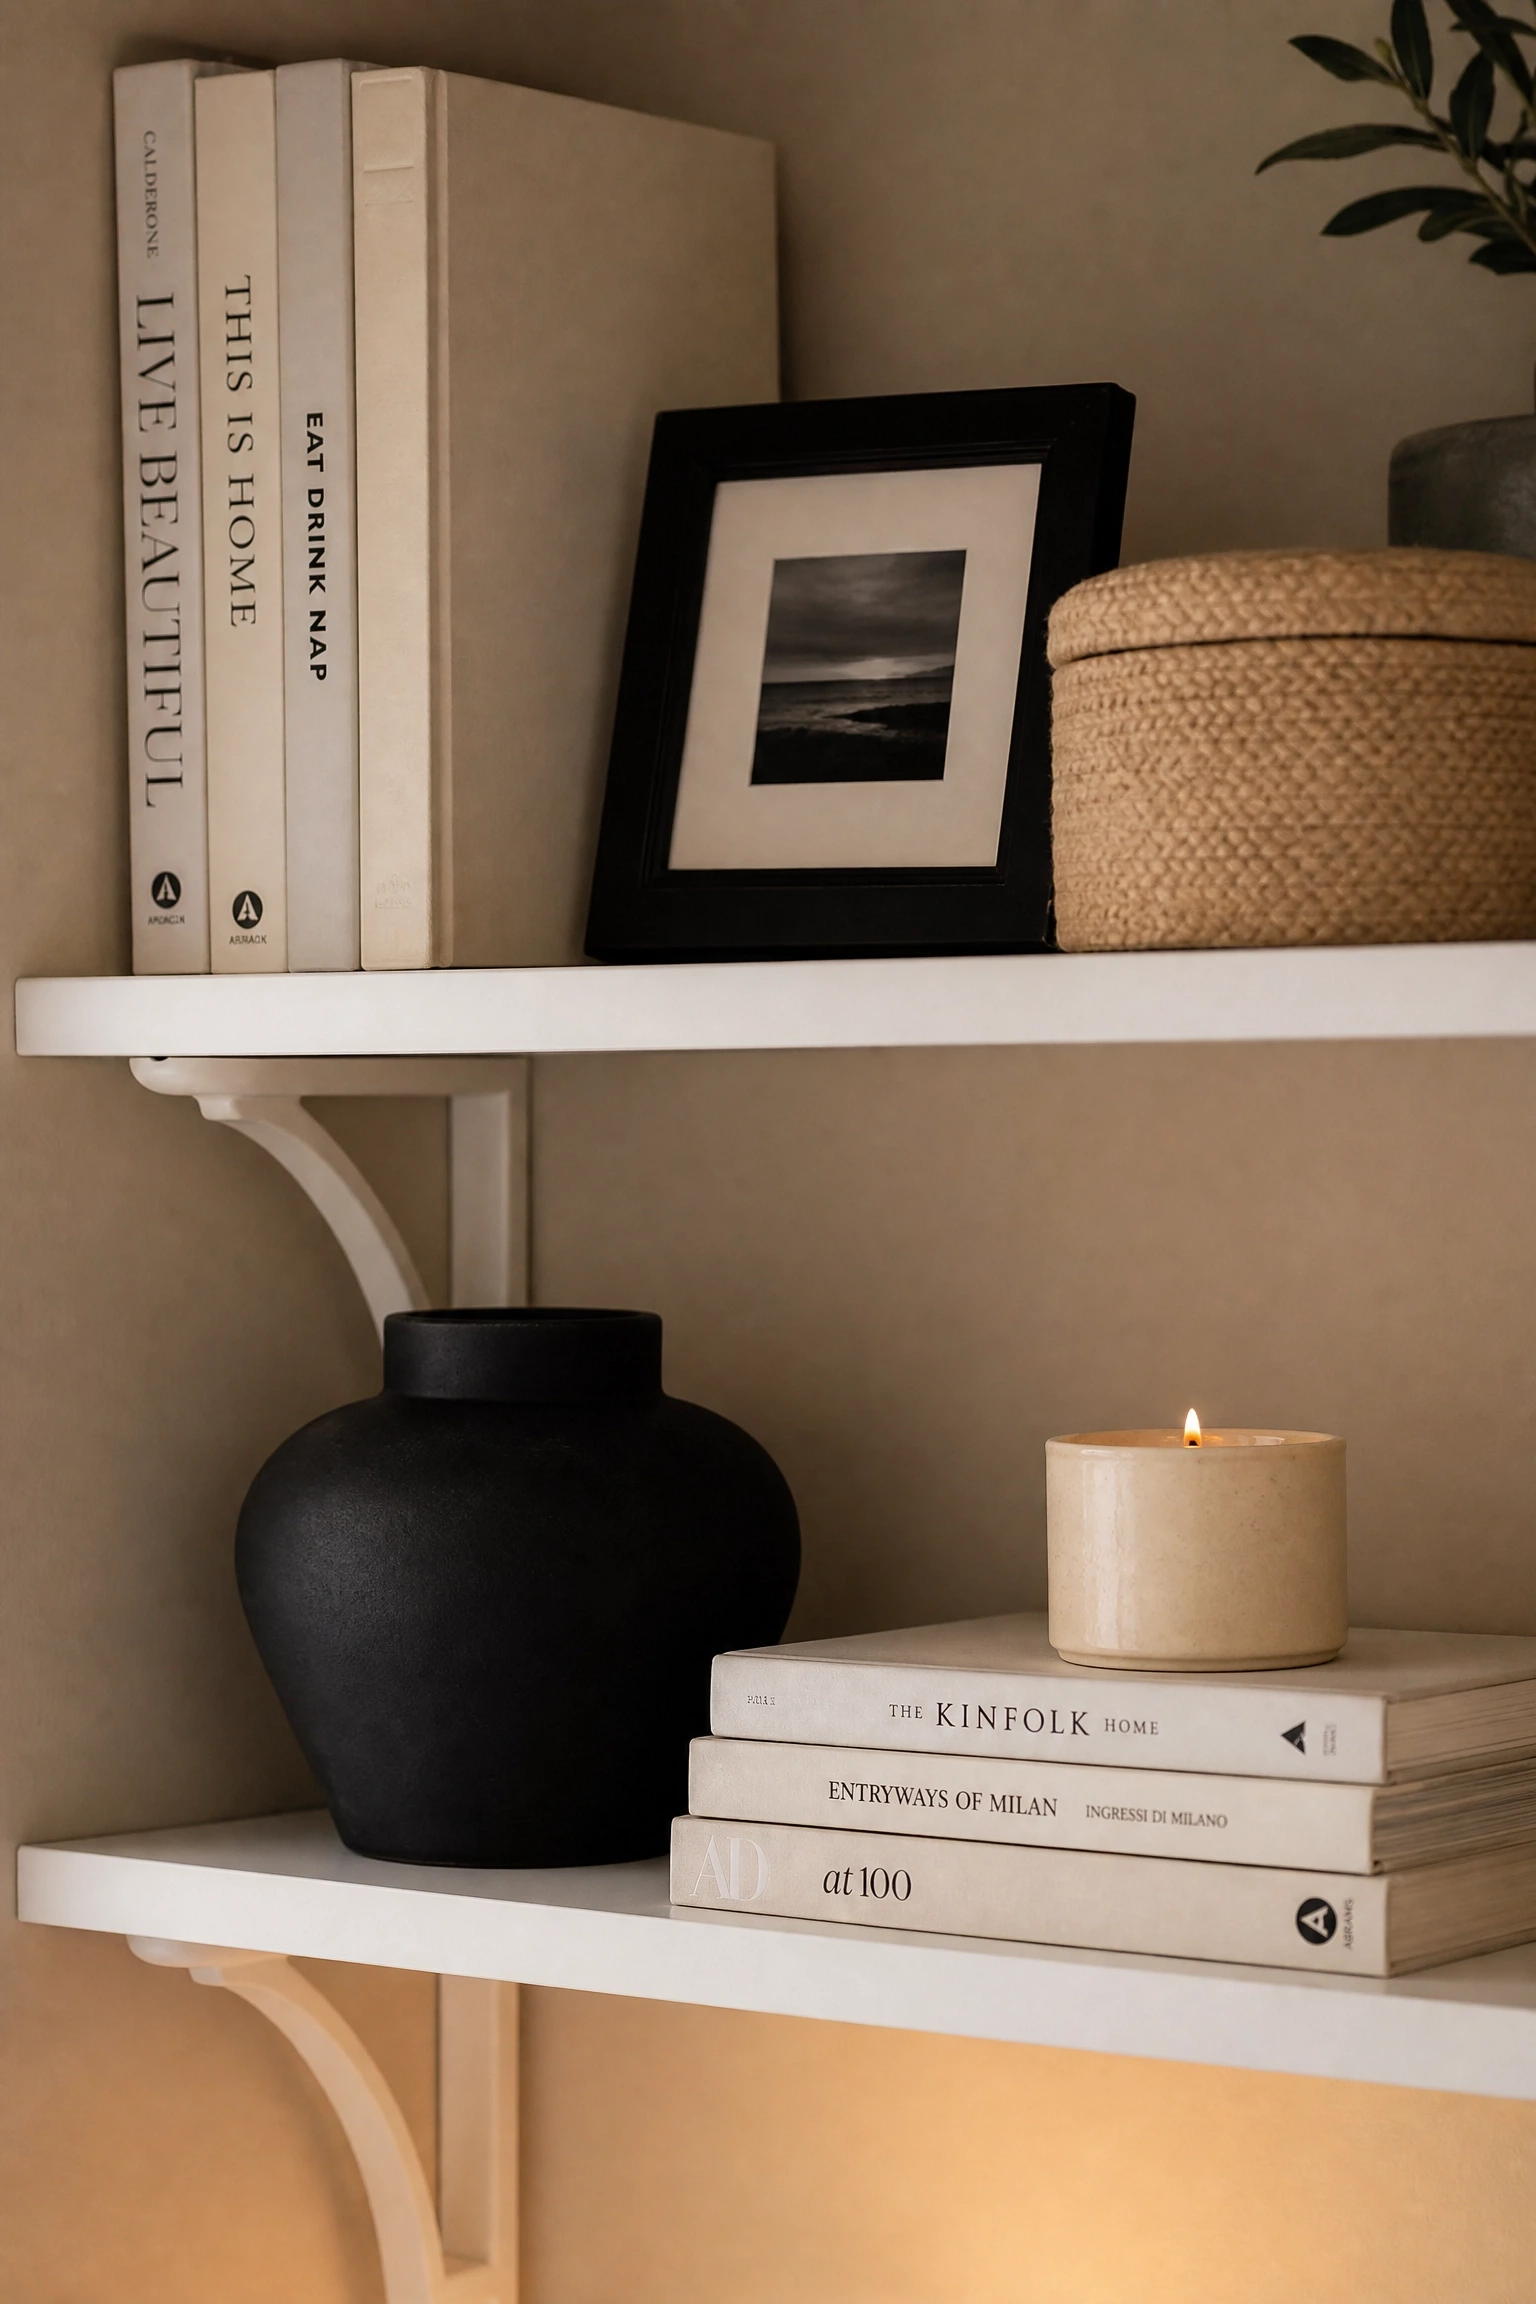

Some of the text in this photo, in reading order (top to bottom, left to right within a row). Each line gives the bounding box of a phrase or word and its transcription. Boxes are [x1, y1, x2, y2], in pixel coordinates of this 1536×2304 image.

[143, 129, 160, 259] CALDERONE
[224, 273, 256, 627] THIS IS HOME
[136, 292, 183, 809] LIVE BEAUTIFUL
[306, 412, 327, 681] EAT DRINK NAP
[888, 1701, 1160, 1737] THE KINFOLK HOME
[828, 1780, 1058, 1818] ENTRYWAYS OF MILAN
[1085, 1804, 1229, 1829] INGRESSI DI MILANO
[689, 1834, 771, 1902] AD
[823, 1866, 913, 1902] at 100
